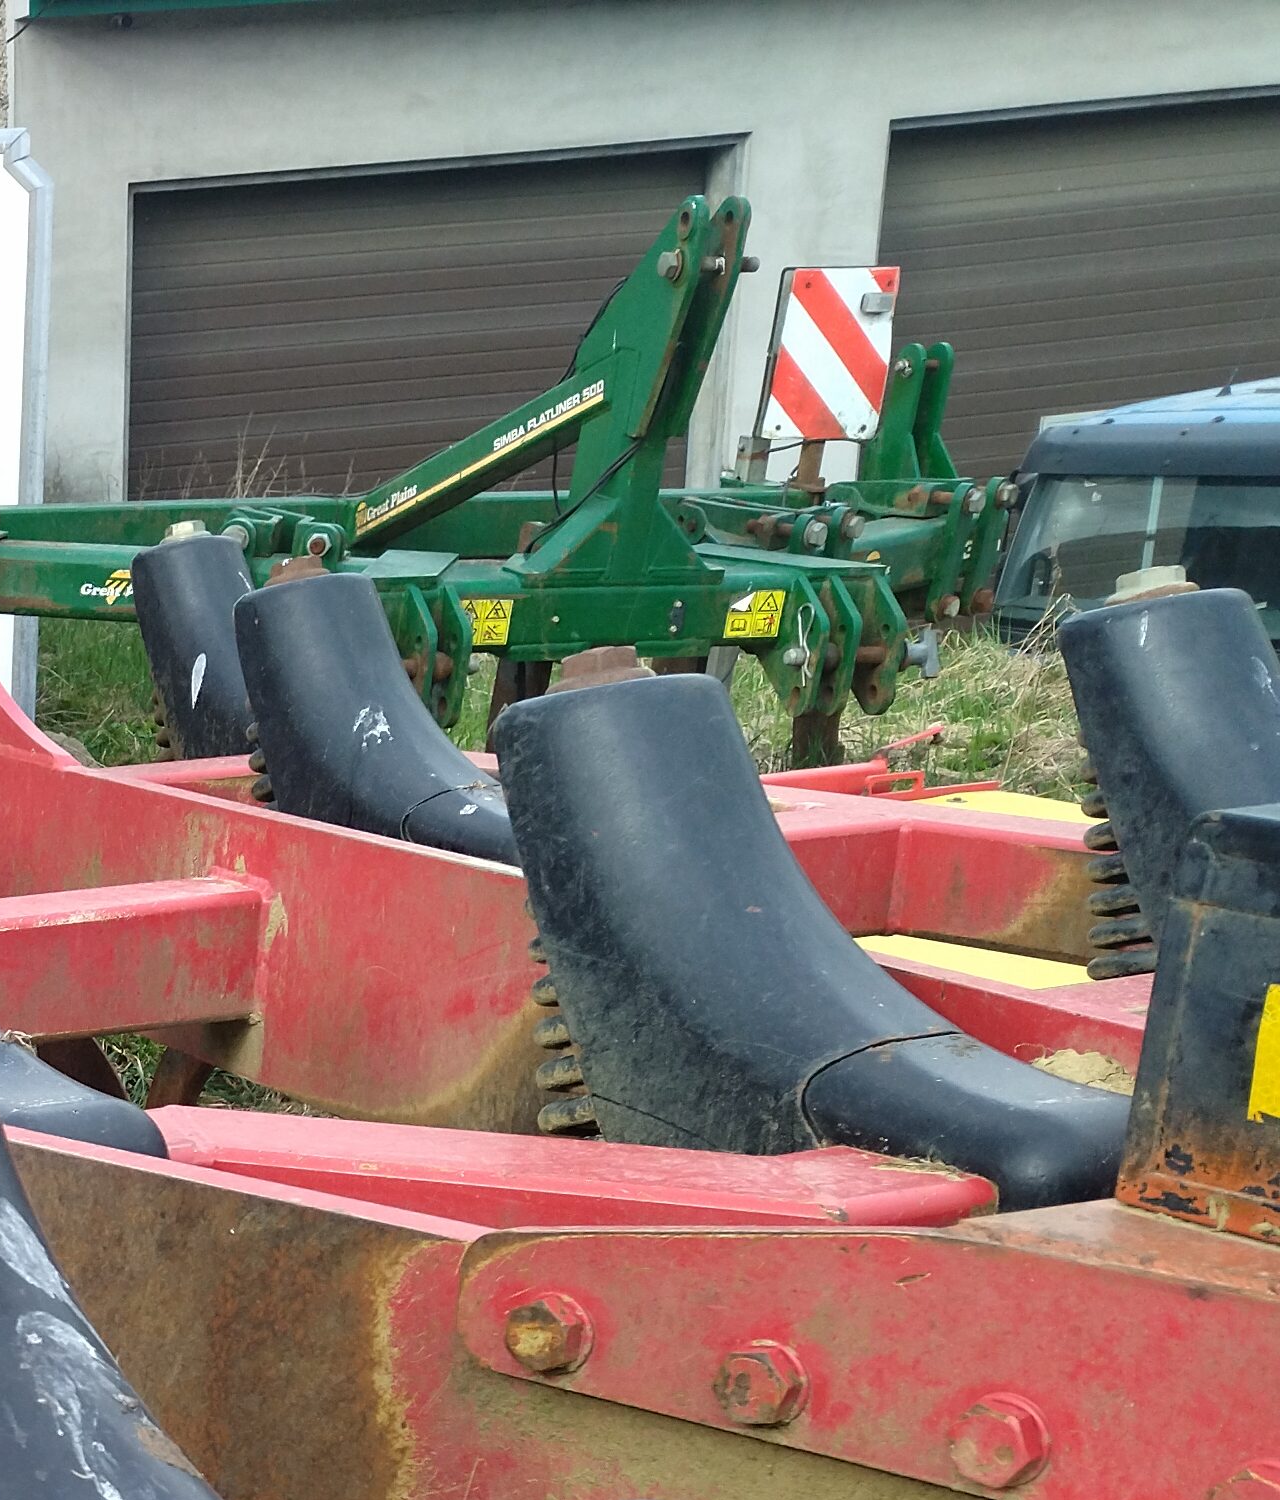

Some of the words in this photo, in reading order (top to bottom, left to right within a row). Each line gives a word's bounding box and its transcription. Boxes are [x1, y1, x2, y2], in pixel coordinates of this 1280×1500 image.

[493, 425, 525, 451] SIMBA
[527, 393, 581, 432] FLATLINER
[581, 379, 604, 401] 500
[367, 498, 389, 521] Great
[391, 484, 418, 509] Plains
[80, 583, 121, 597] Great
